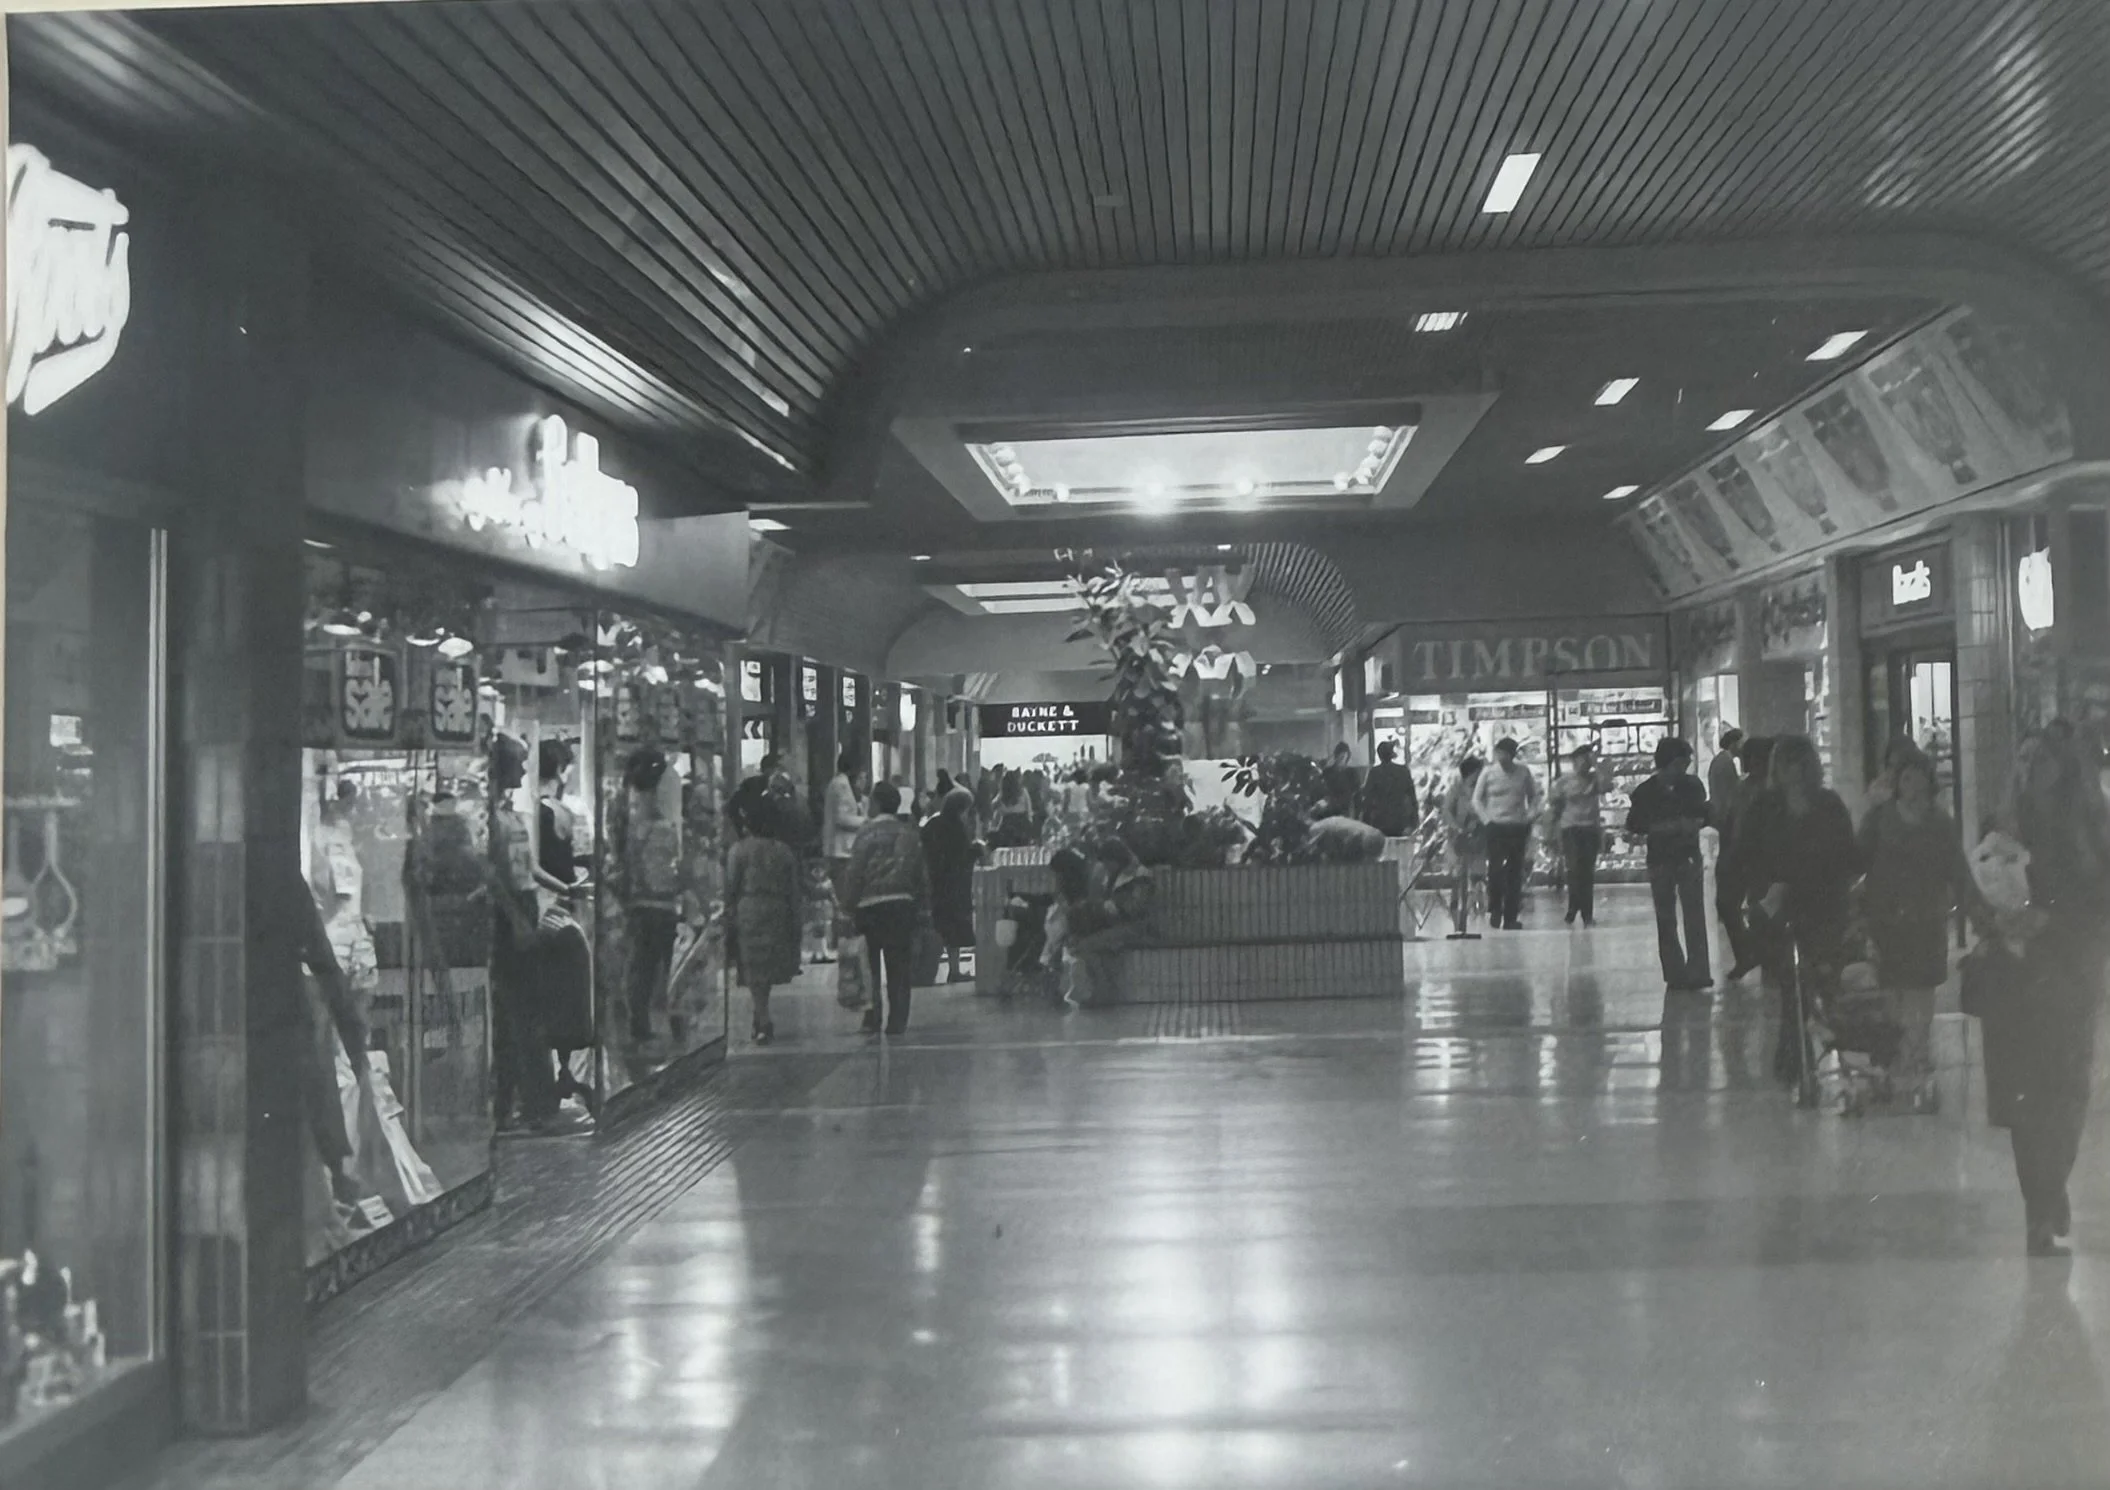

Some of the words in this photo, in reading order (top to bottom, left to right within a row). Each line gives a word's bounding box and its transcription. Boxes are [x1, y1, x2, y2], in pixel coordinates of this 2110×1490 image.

[1413, 634, 1652, 680] TIMPSON
[1011, 706, 1057, 718] BAYNE
[1062, 704, 1074, 717] &
[1007, 720, 1079, 732] DUCKETT
